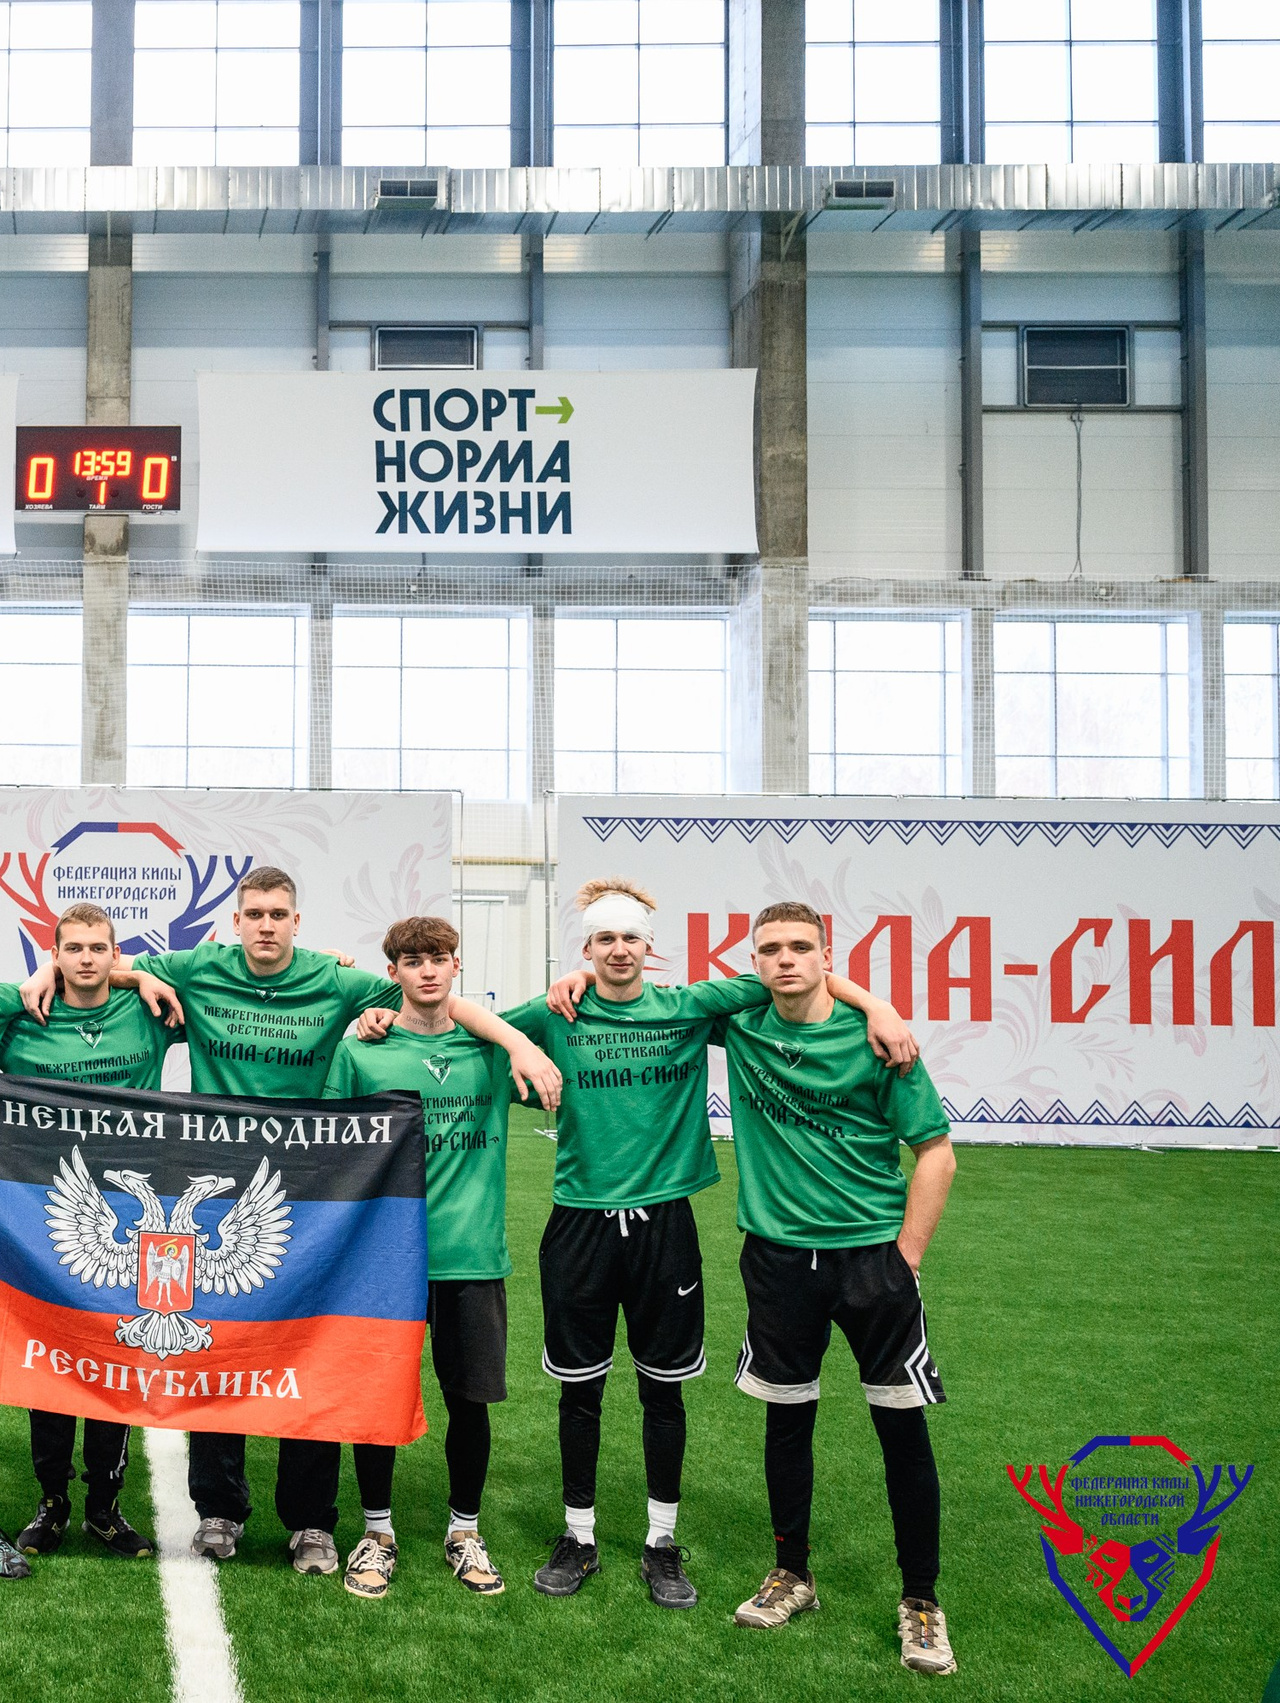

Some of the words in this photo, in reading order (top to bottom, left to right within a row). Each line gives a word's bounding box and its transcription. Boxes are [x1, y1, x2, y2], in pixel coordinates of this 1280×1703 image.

[373, 388, 536, 432] СПОРТ
[74, 450, 132, 476] 13:59
[374, 439, 571, 484] НОРМА
[28, 457, 55, 499] 0
[142, 457, 169, 499] 0
[99, 481, 106, 504] 1
[374, 490, 573, 535] ЖИЗНИ
[53, 866, 137, 881] ФЕДЕРАЦИЯ
[142, 867, 182, 880] КИЛЫ
[57, 884, 177, 902] НИЖЕГОРОДСКОЙ
[105, 906, 148, 920] ЛАСТИ
[204, 1005, 325, 1027] МЕЖРЕГИОНАЛЬНЫЙ
[227, 1022, 297, 1040] ФЕСТИВАЛЬ
[566, 1025, 695, 1047] МЕЖРЕГИОНАЛЬНЫЙ
[36, 1048, 150, 1074] МЕЖРЕГИОНАЛЬНЫЙ
[595, 1044, 672, 1062] ФЕСТИВАЛЬ
[422, 1093, 493, 1110] ЕГИОНАЛЬНЫЙ
[180, 1112, 393, 1151] НАРОДНАЯ
[21, 1338, 302, 1401] РЕСПУБЛИКА
